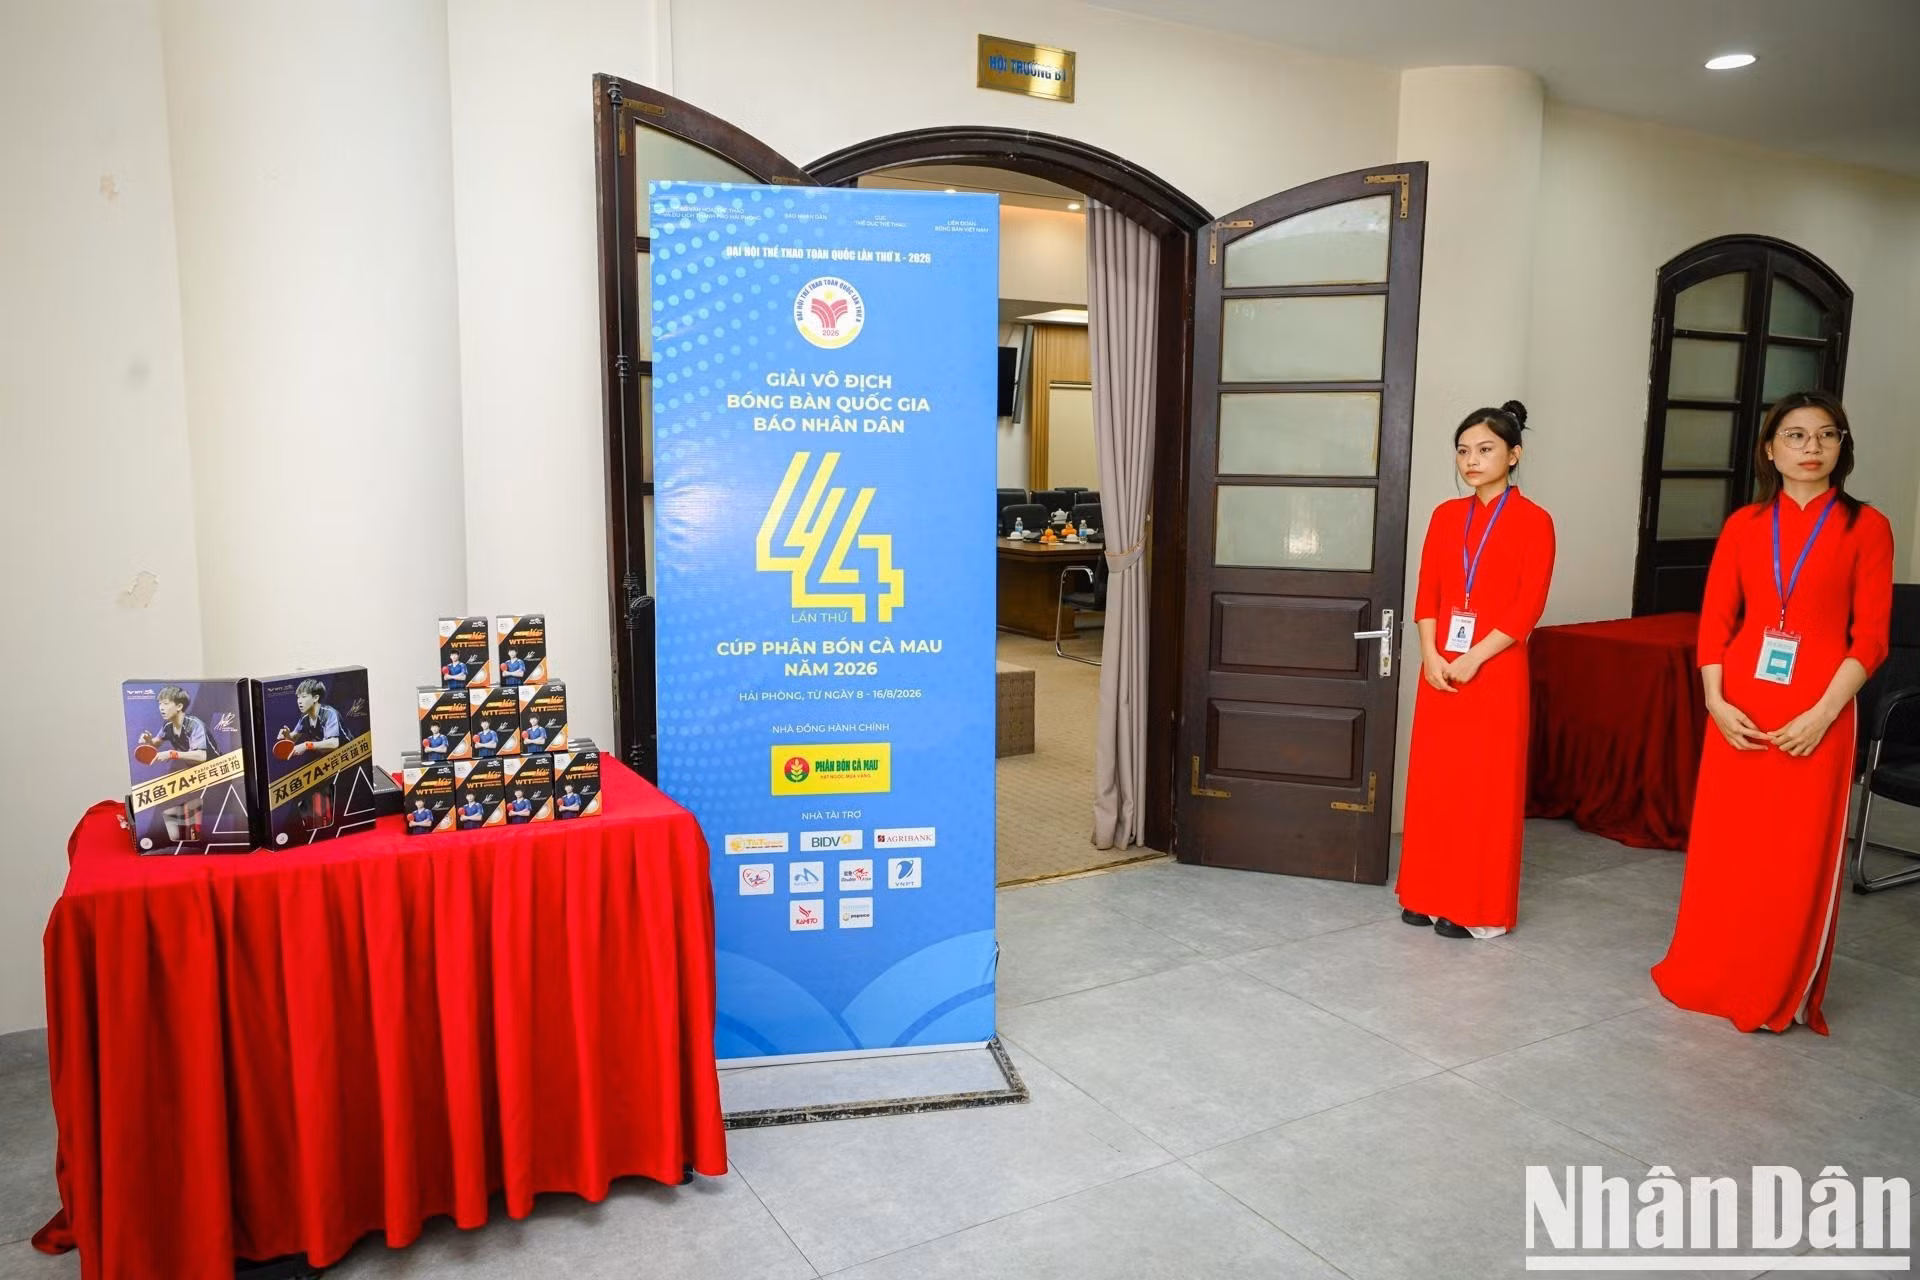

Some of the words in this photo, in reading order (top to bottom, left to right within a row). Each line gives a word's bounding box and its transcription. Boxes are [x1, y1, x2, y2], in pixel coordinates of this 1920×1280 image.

[781, 248, 803, 259] THAO
[806, 247, 829, 260] TOÀN
[831, 246, 855, 261] QUỐC
[766, 368, 805, 387] GIẢI
[811, 370, 839, 388] VÔ
[844, 374, 892, 392] ĐỊCH
[727, 391, 784, 409] BÓNG
[789, 391, 831, 410] BÀN
[836, 392, 893, 413] QUỐC
[897, 397, 930, 412] GIA
[753, 414, 796, 432] BÁO
[802, 415, 857, 433] NHÂN
[863, 416, 905, 433] DÂN
[820, 610, 848, 623] THỨ
[716, 638, 757, 656] CÚP
[762, 637, 816, 655] PHÂN
[822, 637, 864, 655] BÓN
[869, 636, 895, 654] CÀ
[901, 639, 943, 654] MAU
[784, 659, 828, 677] NĂM
[833, 661, 878, 676] 2026
[739, 690, 758, 702] HẢI
[761, 688, 805, 702] PHÒNG,
[807, 688, 822, 699] TỪ
[824, 688, 854, 700] NGÀY
[857, 690, 863, 699] 8
[873, 689, 922, 700] 16/8/2026
[481, 709, 499, 717] WTT
[772, 723, 794, 734] NHÀ
[828, 723, 856, 733] HÀNH
[815, 758, 835, 773] PHÂN
[836, 758, 851, 772] BÓN
[852, 758, 862, 771] CÀ
[863, 759, 879, 770] MAU
[802, 811, 823, 820] NHÀ
[825, 810, 840, 819] TÀI
[843, 809, 862, 819] TRỢ
[811, 836, 840, 848] BIDV
[886, 834, 932, 843] AGRIBANK
